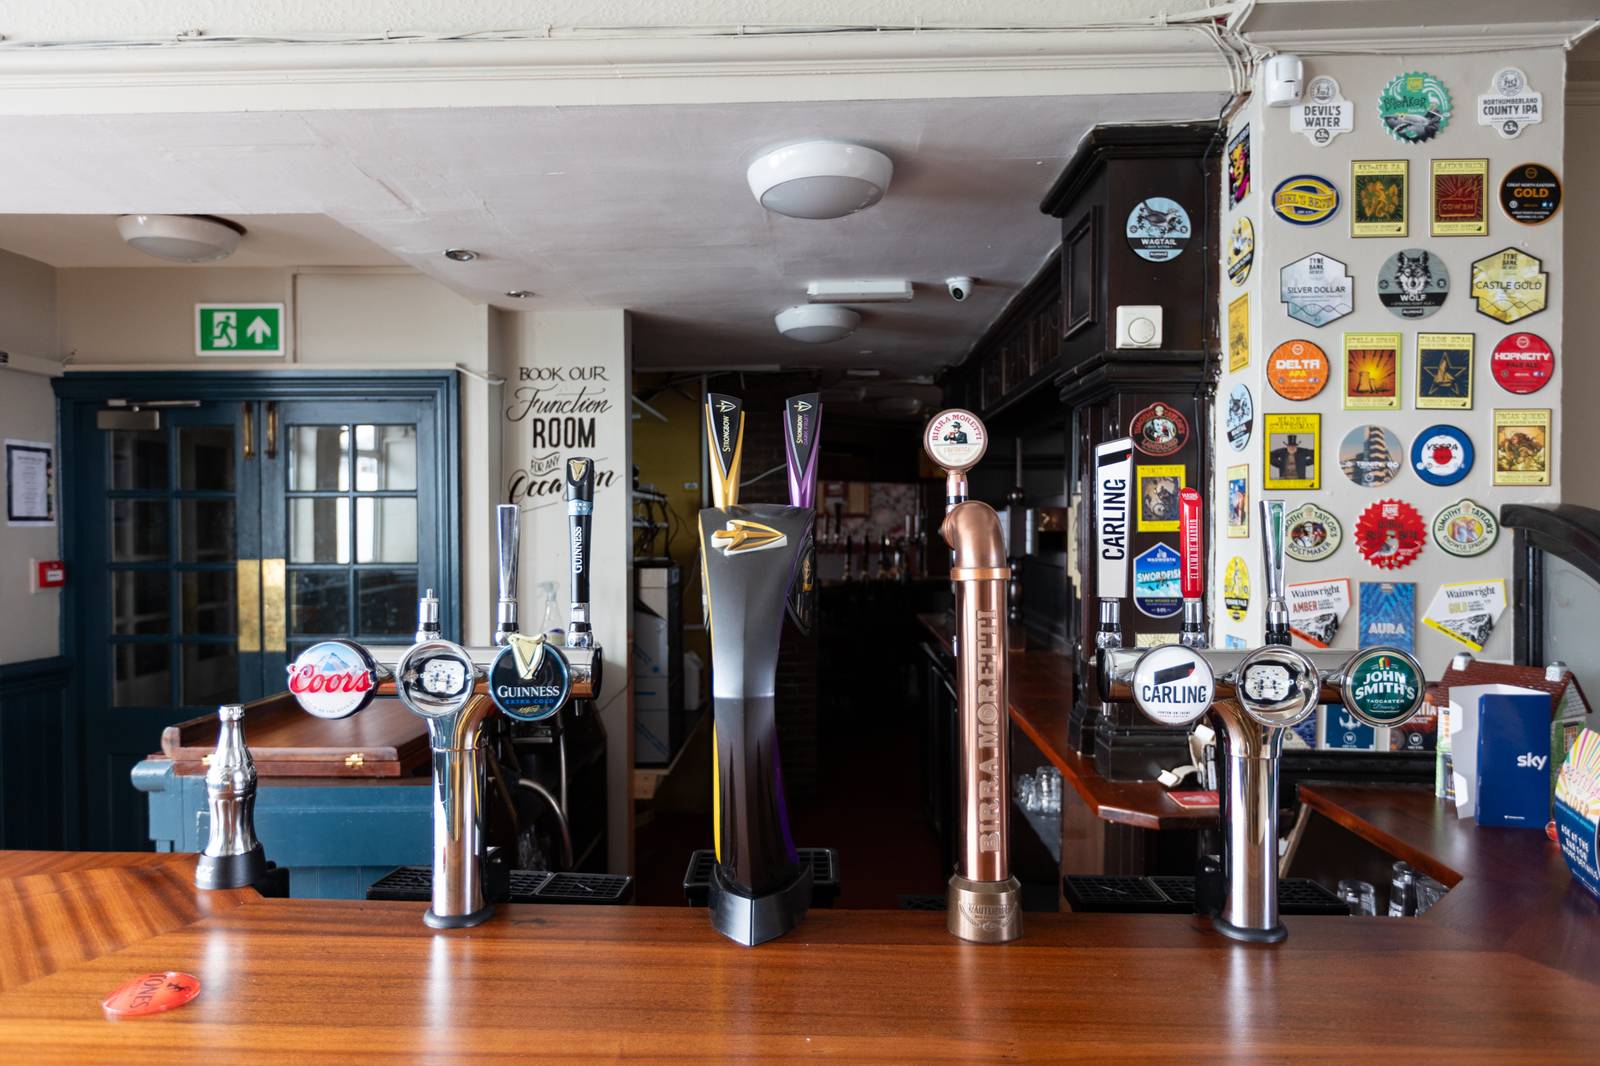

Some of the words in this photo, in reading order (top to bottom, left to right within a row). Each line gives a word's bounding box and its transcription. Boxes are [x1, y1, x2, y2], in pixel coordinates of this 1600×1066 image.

[1304, 106, 1341, 116] DEVIL'S
[1483, 105, 1520, 115] COUNTY
[1522, 104, 1538, 114] IPA
[1304, 117, 1340, 127] WATER
[1514, 188, 1549, 198] GOLD
[1142, 238, 1177, 246] WAGTAIL
[1314, 286, 1346, 294] DOLLAR
[1476, 281, 1512, 290] CASTLE
[1514, 281, 1542, 290] GOLD
[1400, 294, 1426, 302] WOLF
[1276, 360, 1320, 370] DELTA
[520, 366, 564, 381] BOOK
[569, 366, 610, 381] OUR
[506, 384, 613, 422] Function
[533, 417, 596, 448] ROOM
[722, 416, 731, 452] STRONGBOW
[796, 415, 804, 444] STRONGBOW
[932, 416, 951, 440] BIRRA
[952, 414, 982, 440] MORETTI
[530, 458, 544, 473] FOR
[545, 455, 560, 470] ANY
[508, 468, 622, 505] Occan
[1102, 479, 1126, 561] CARLING
[1314, 512, 1338, 537] TAYLOR'S
[1438, 507, 1461, 531] TIMOTHY
[1472, 508, 1493, 534] TAYLOR'S
[573, 526, 583, 574] GUINNESS
[1288, 542, 1331, 556] BOLTMAKER
[1190, 554, 1198, 570] ALMA
[1291, 585, 1340, 599] Wainwright
[1446, 586, 1495, 598] Wainwright
[1293, 601, 1318, 614] AMBER
[1368, 623, 1405, 634] AURA
[288, 664, 372, 693] Coors
[976, 610, 998, 749] MORETTI
[1363, 671, 1406, 685] JOHN
[497, 685, 560, 698] GUINNESS
[1142, 685, 1207, 704] CARLING
[1355, 682, 1415, 700] SMITH'S
[1517, 752, 1548, 770] sky
[978, 759, 1000, 853] BIRRA
